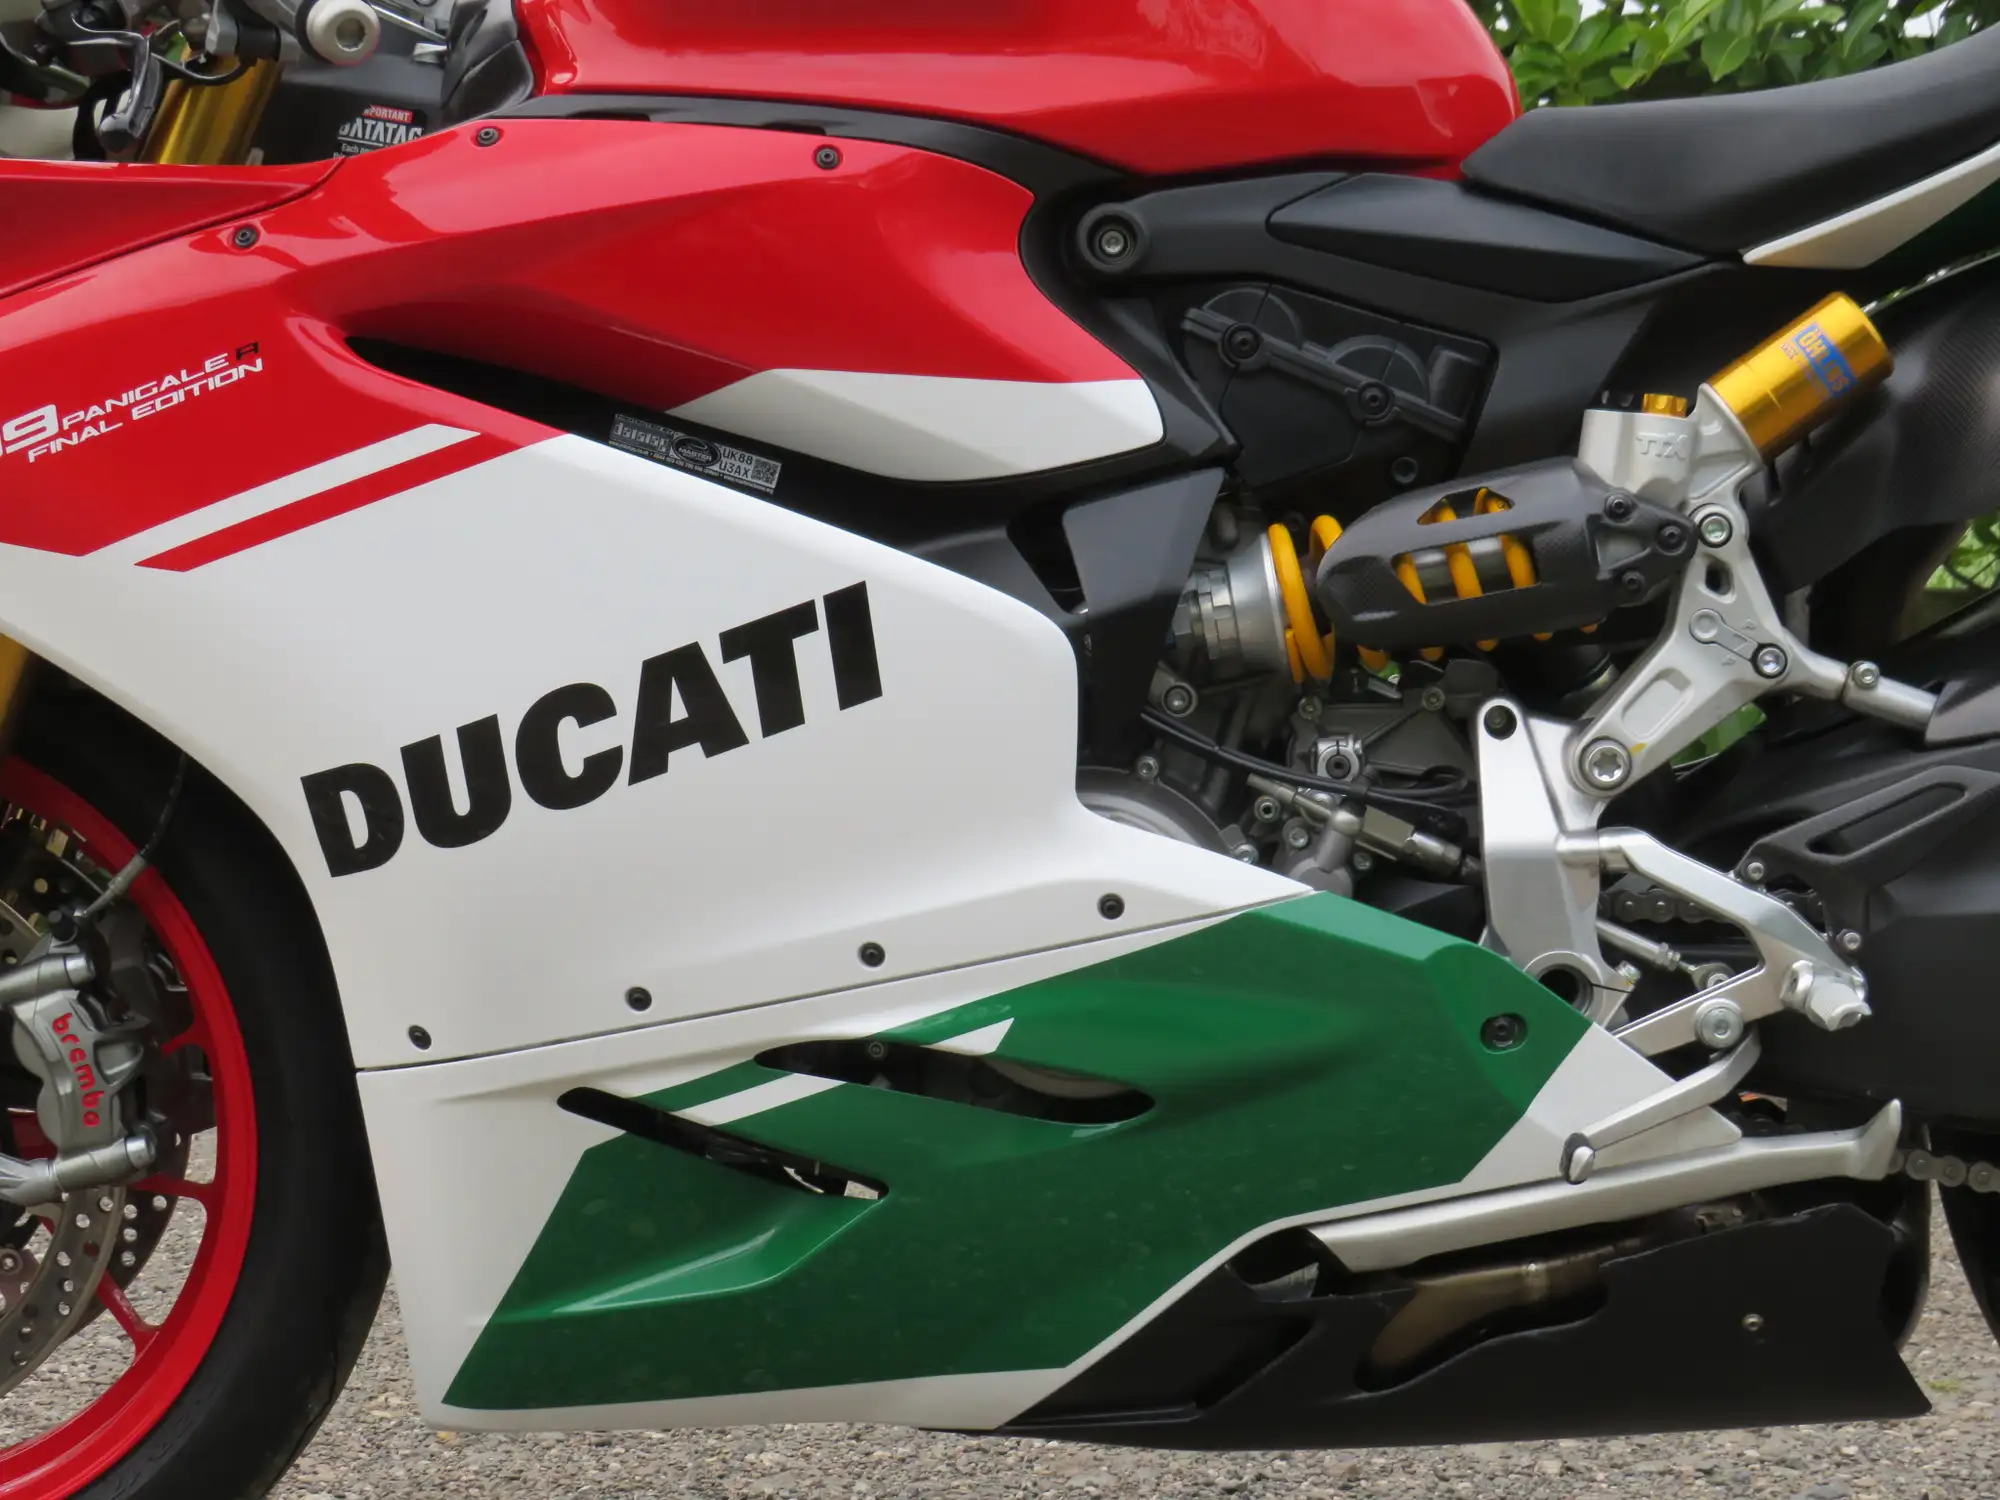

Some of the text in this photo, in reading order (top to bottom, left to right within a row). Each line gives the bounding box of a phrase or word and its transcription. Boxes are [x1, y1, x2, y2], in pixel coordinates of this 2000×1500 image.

[341, 143, 359, 153] Each
[362, 106, 410, 121] MPORTANT
[0, 404, 59, 457] 9
[62, 353, 228, 430] PANIGALE
[28, 358, 262, 463] FINAL EDITION
[718, 461, 750, 479] U3AX
[300, 580, 883, 878] DUCATI
[52, 1012, 104, 1127] brembo
